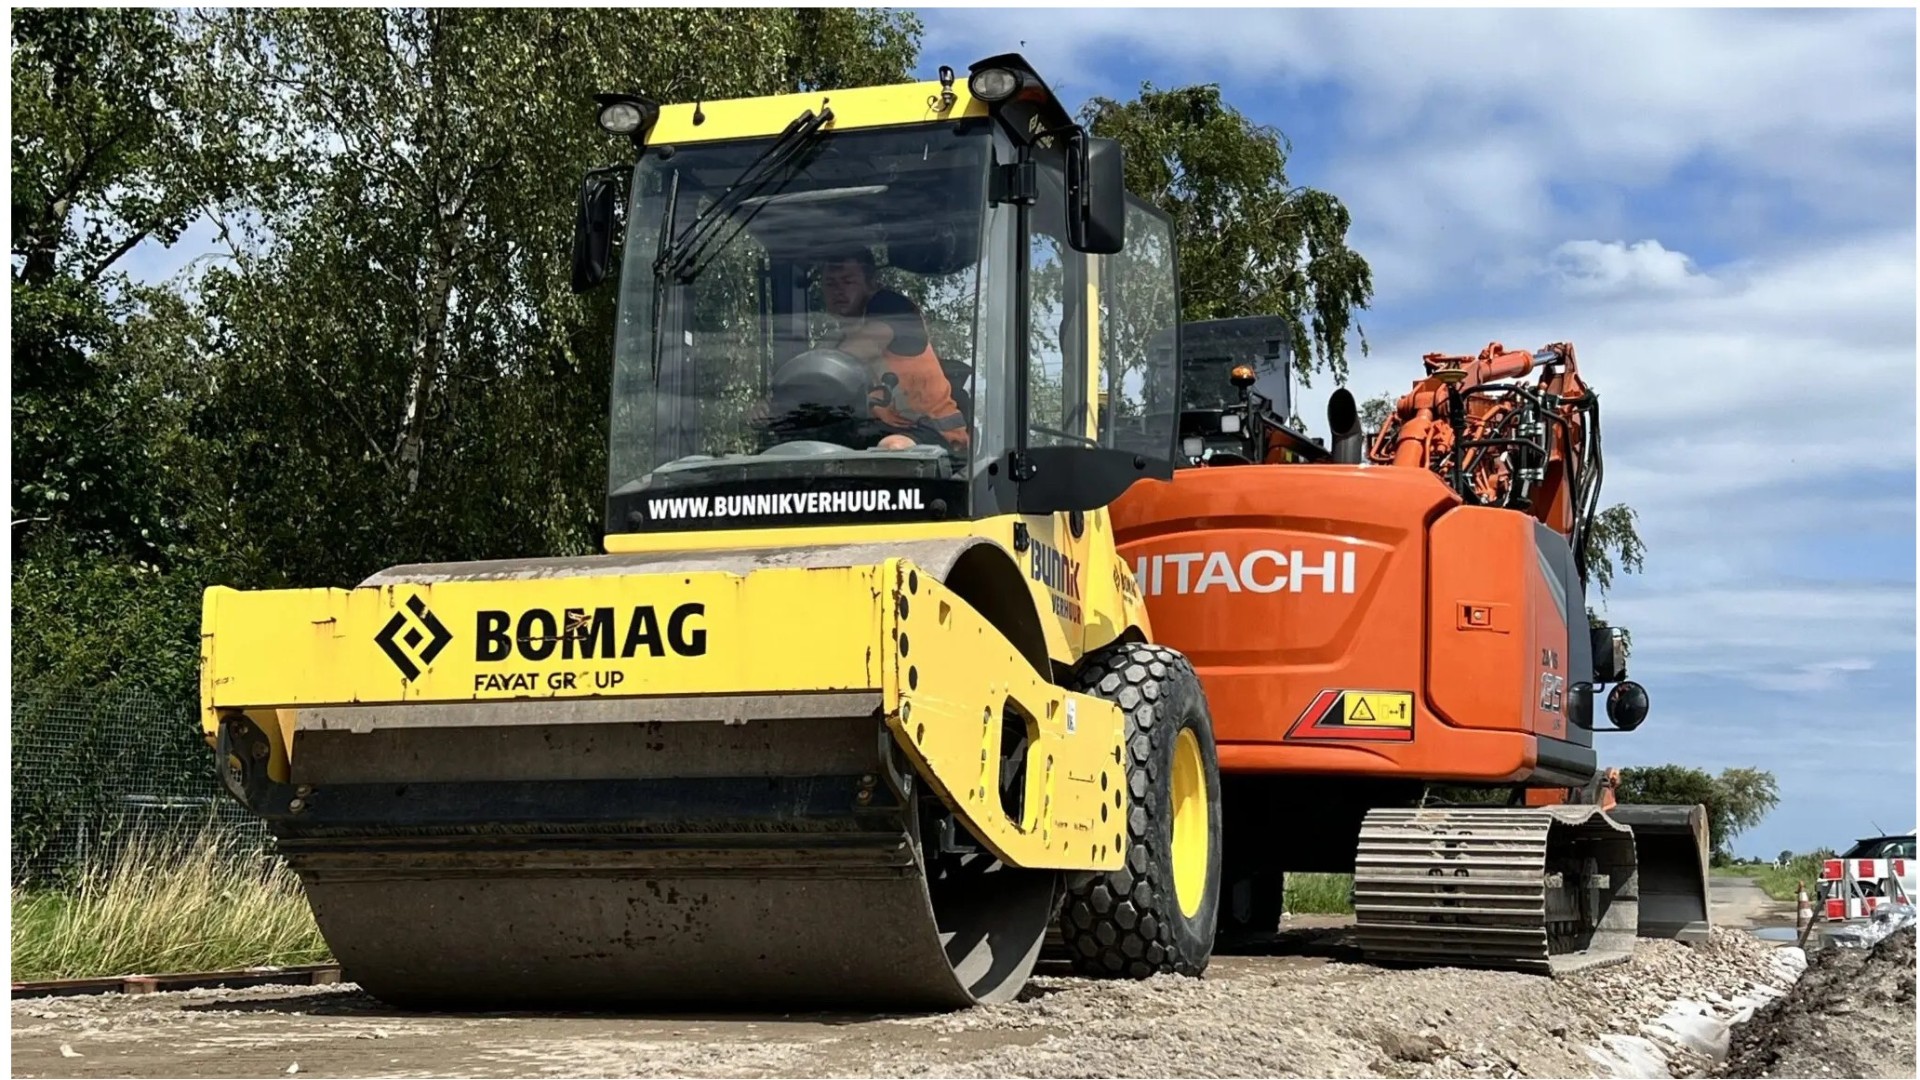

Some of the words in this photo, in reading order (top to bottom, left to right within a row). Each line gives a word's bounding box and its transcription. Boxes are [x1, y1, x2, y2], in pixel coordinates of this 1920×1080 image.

[648, 488, 925, 520] WWW.BUNNIKVERHUUR.NL
[475, 602, 707, 662] BOMAG
[474, 673, 540, 692] FAYAT
[547, 671, 625, 690] GRUP
